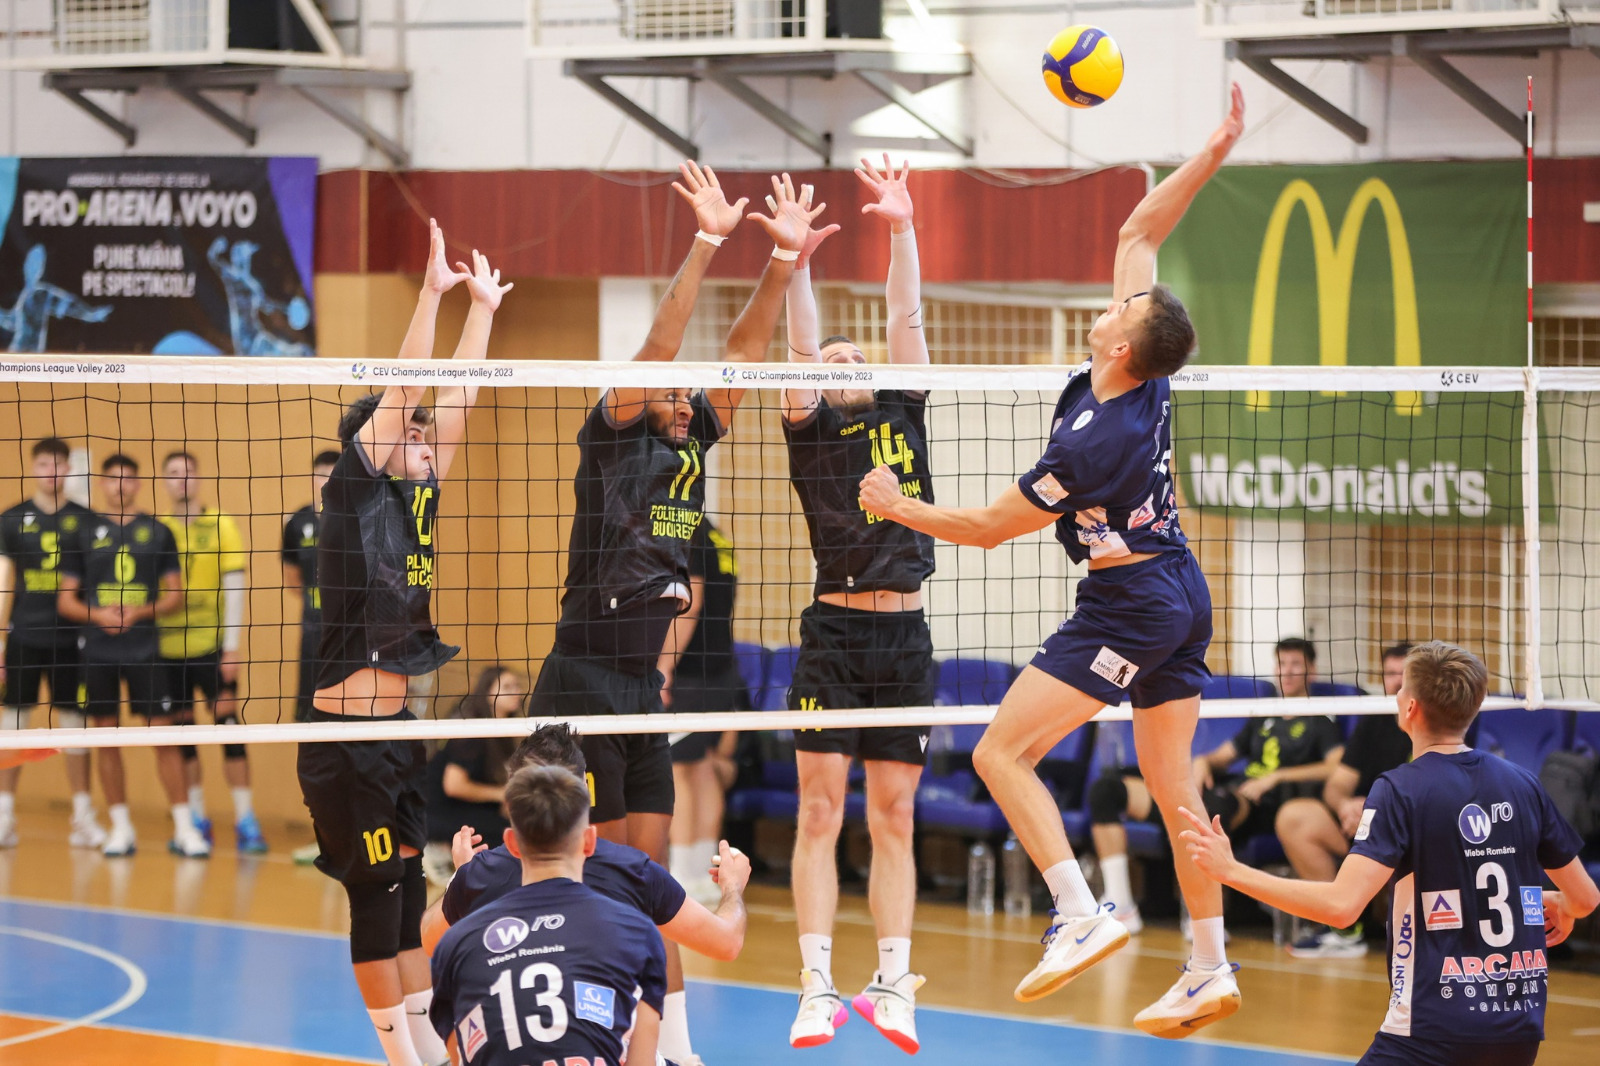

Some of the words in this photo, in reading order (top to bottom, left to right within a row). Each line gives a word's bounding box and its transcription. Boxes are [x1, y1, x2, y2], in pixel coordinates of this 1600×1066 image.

[179, 190, 257, 228] VOYO
[0, 363, 41, 374] hampions
[43, 363, 75, 374] League
[77, 364, 103, 375] Volley
[105, 364, 125, 373] 2023
[373, 367, 389, 376] CEV
[391, 367, 435, 378] Champions
[438, 367, 467, 378] League
[469, 368, 492, 379] Volley
[495, 368, 513, 377] 2023
[742, 371, 758, 380] CEV
[759, 371, 801, 382] Champions
[803, 371, 829, 382] League
[831, 372, 853, 382] Volley
[855, 372, 873, 381] 2023
[1192, 373, 1209, 382] 2023
[1457, 373, 1479, 384] CEV
[868, 422, 914, 474] 14
[1189, 452, 1492, 518] McDonald's
[363, 827, 393, 865] 10
[1475, 861, 1514, 948] 3
[487, 952, 517, 967] Wiebe
[489, 962, 569, 1051] 13
